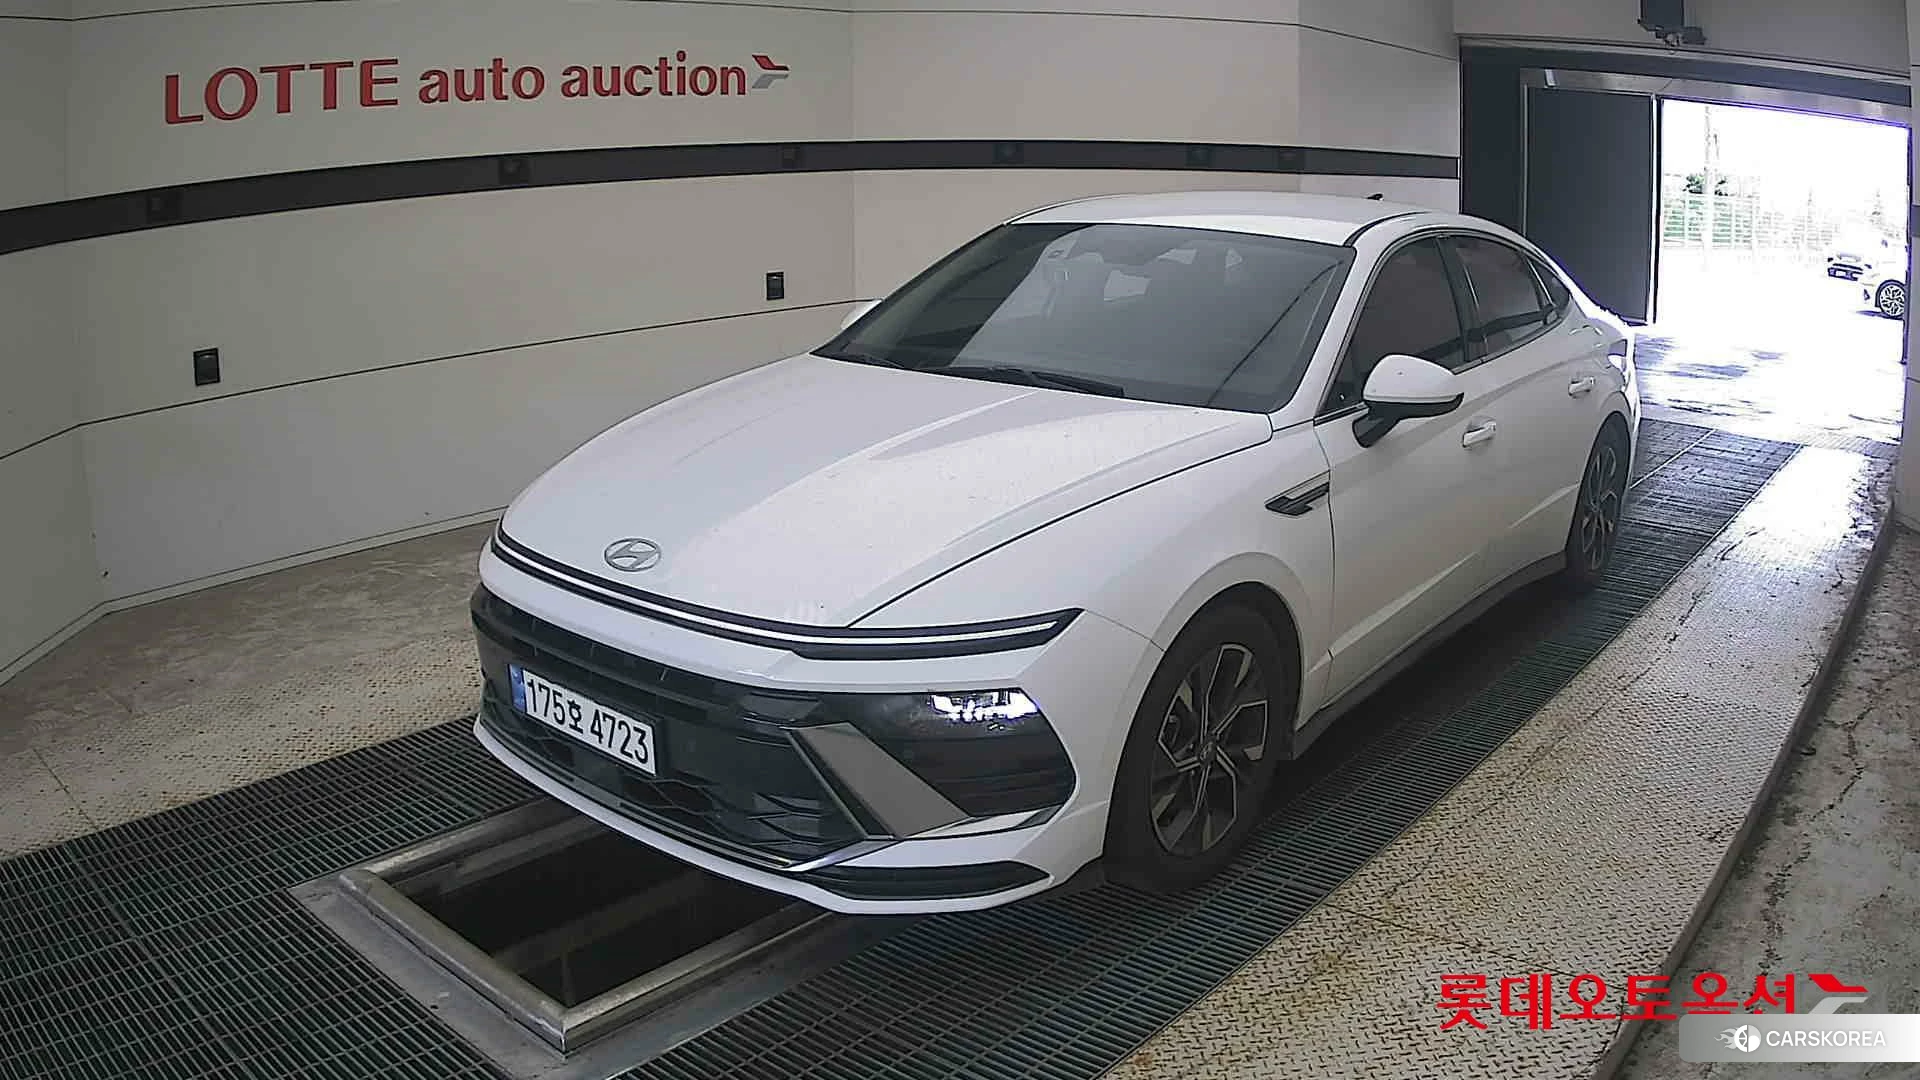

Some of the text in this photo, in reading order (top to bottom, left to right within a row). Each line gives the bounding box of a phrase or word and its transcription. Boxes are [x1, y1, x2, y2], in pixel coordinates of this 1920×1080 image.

[164, 51, 748, 125] LOTTE auto auction
[526, 678, 649, 765] 175호 4723
